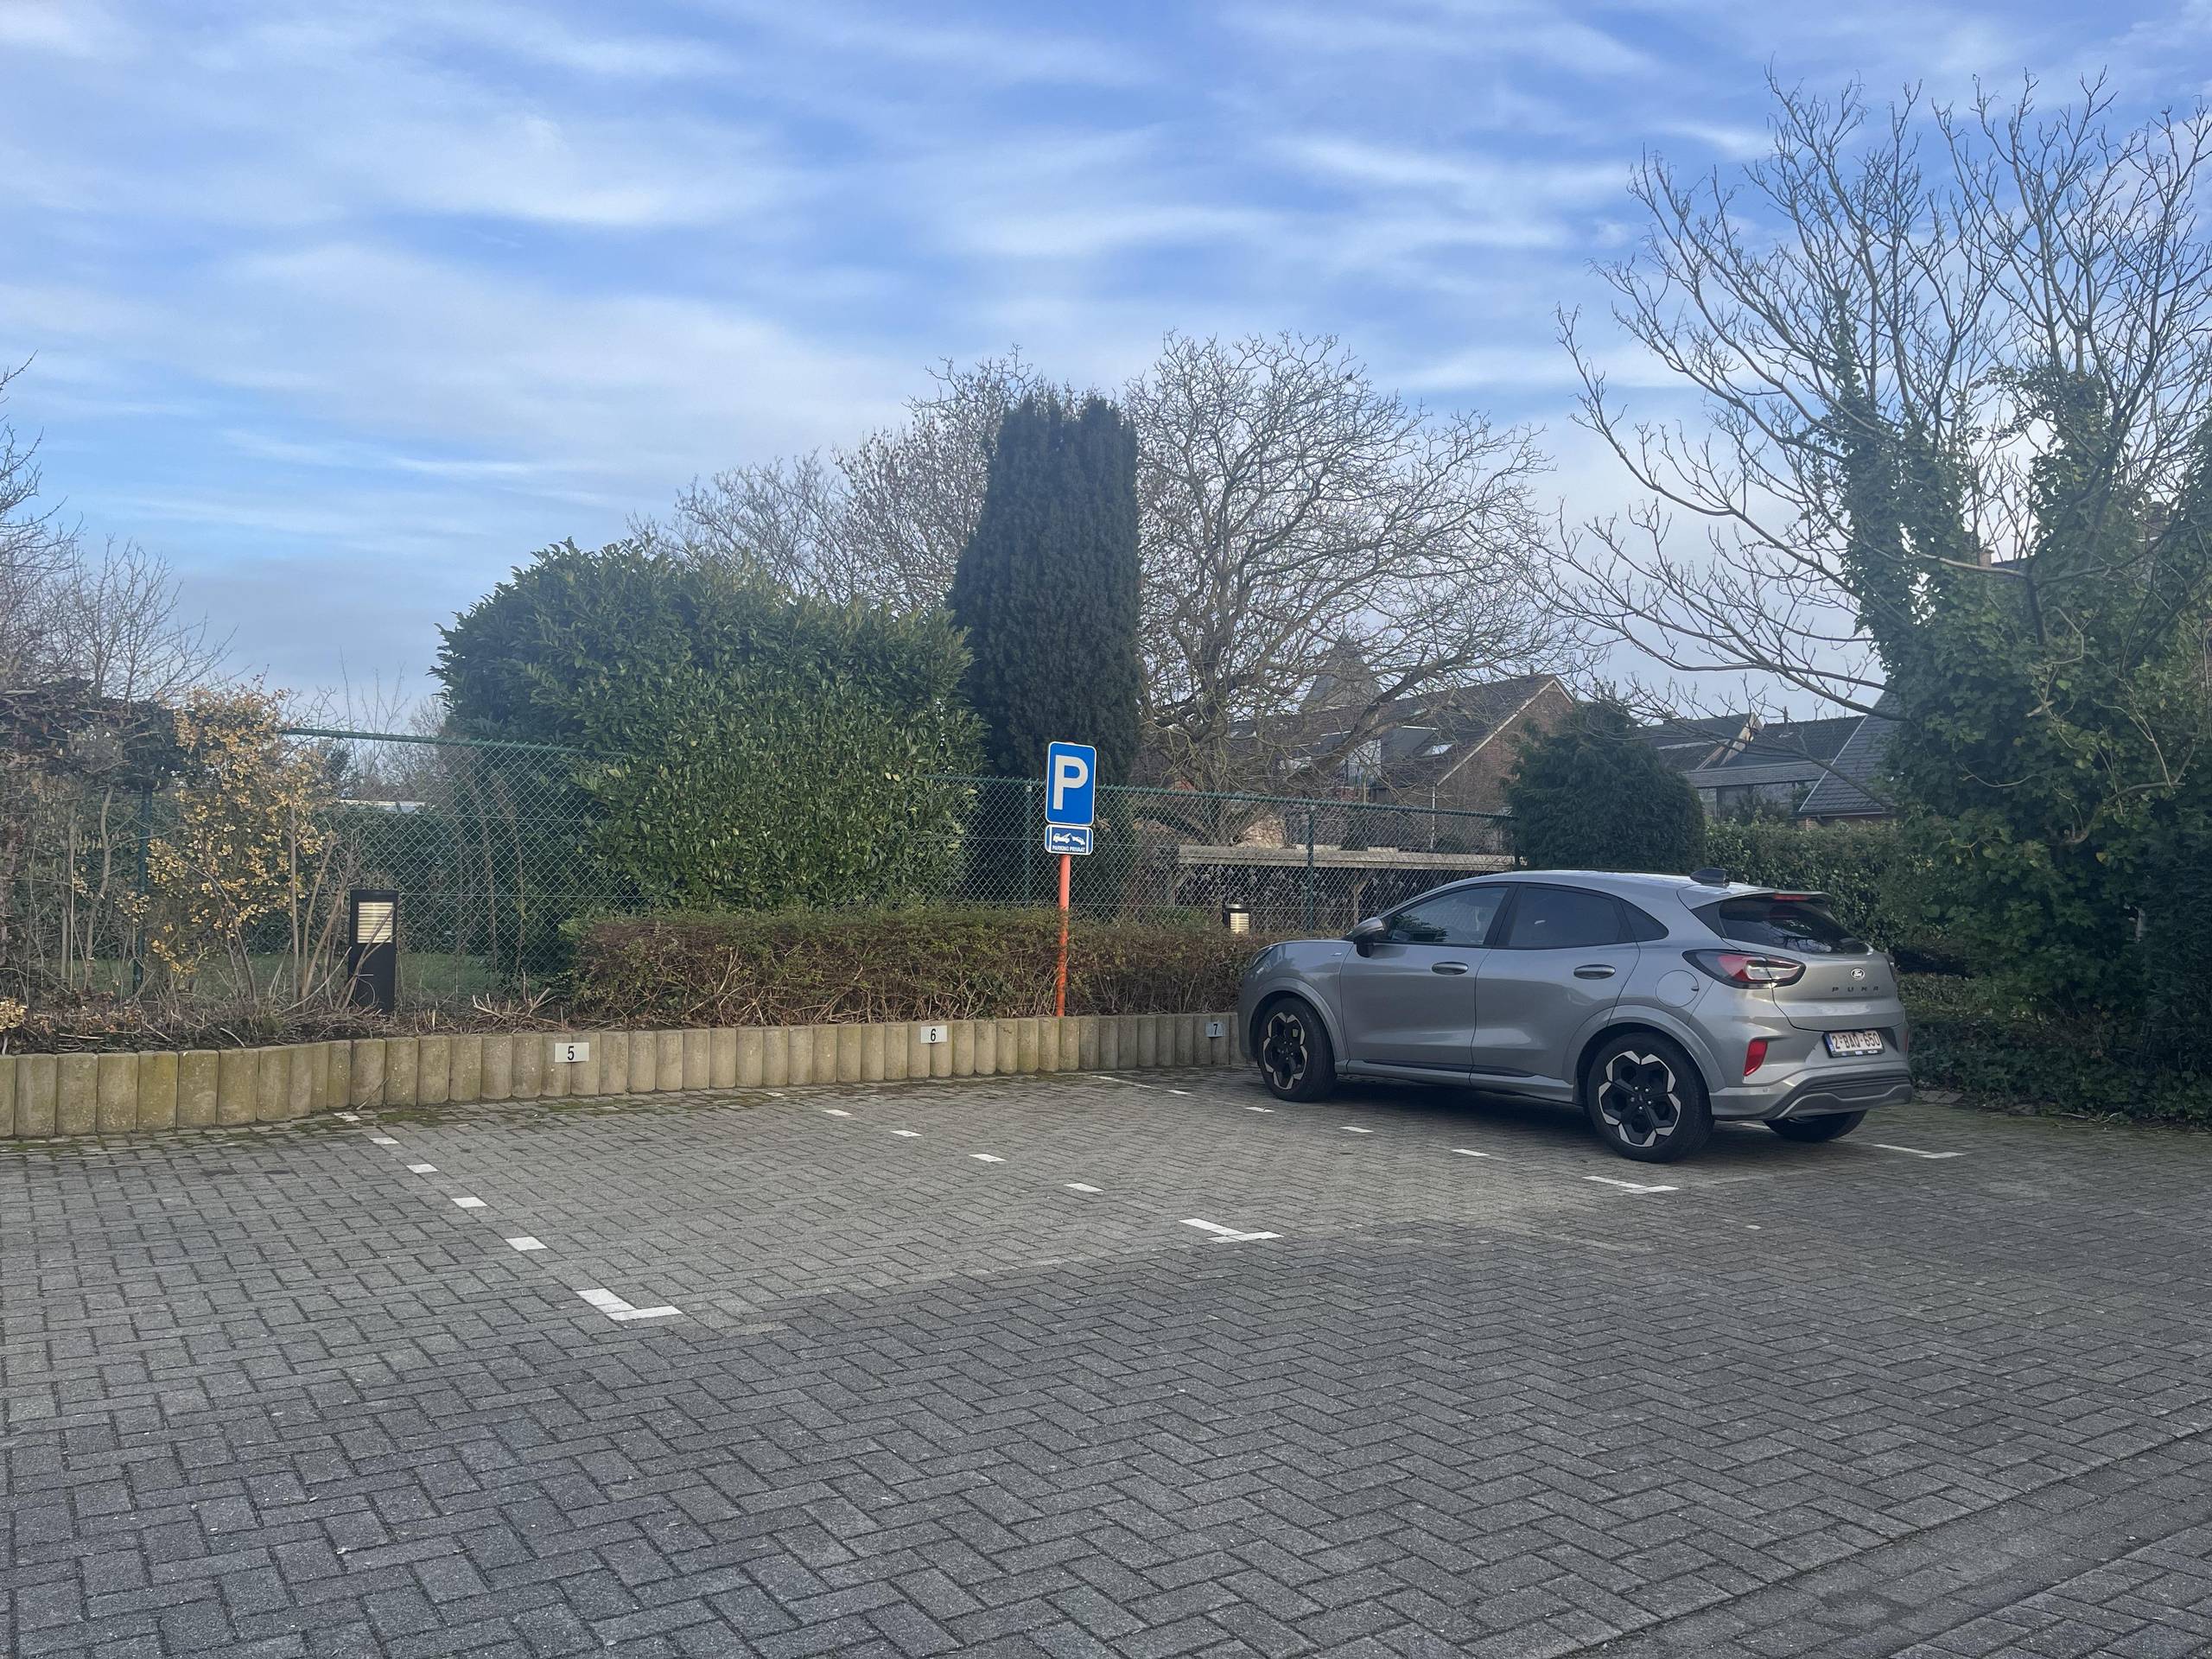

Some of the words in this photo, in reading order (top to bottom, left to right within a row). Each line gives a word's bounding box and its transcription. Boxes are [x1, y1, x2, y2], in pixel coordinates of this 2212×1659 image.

[1053, 754, 1089, 810] P
[930, 1027, 937, 1042] 6
[1213, 1023, 1218, 1036] 7
[567, 1045, 575, 1061] 5
